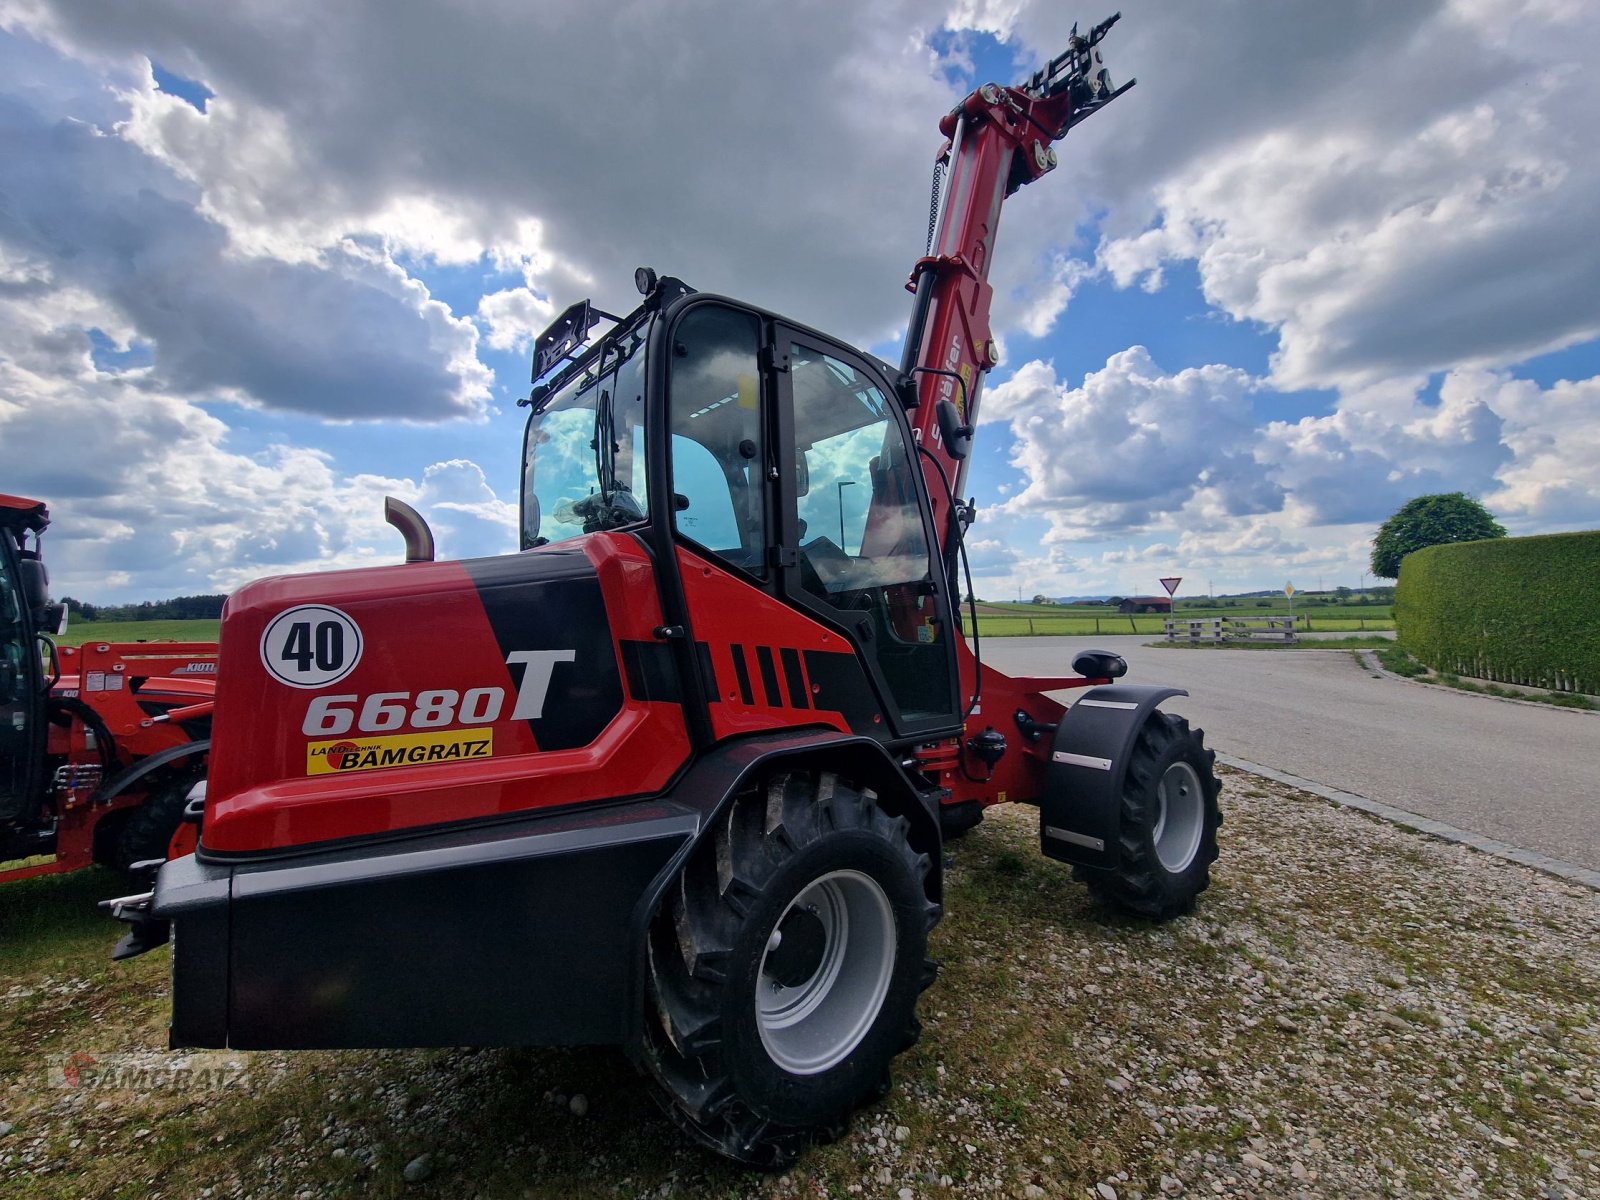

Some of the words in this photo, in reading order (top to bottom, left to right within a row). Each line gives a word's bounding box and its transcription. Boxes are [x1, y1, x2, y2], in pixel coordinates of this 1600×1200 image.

[281, 621, 344, 672] 40
[186, 662, 216, 673] KIOTI
[339, 740, 490, 770] BAMGRATZ
